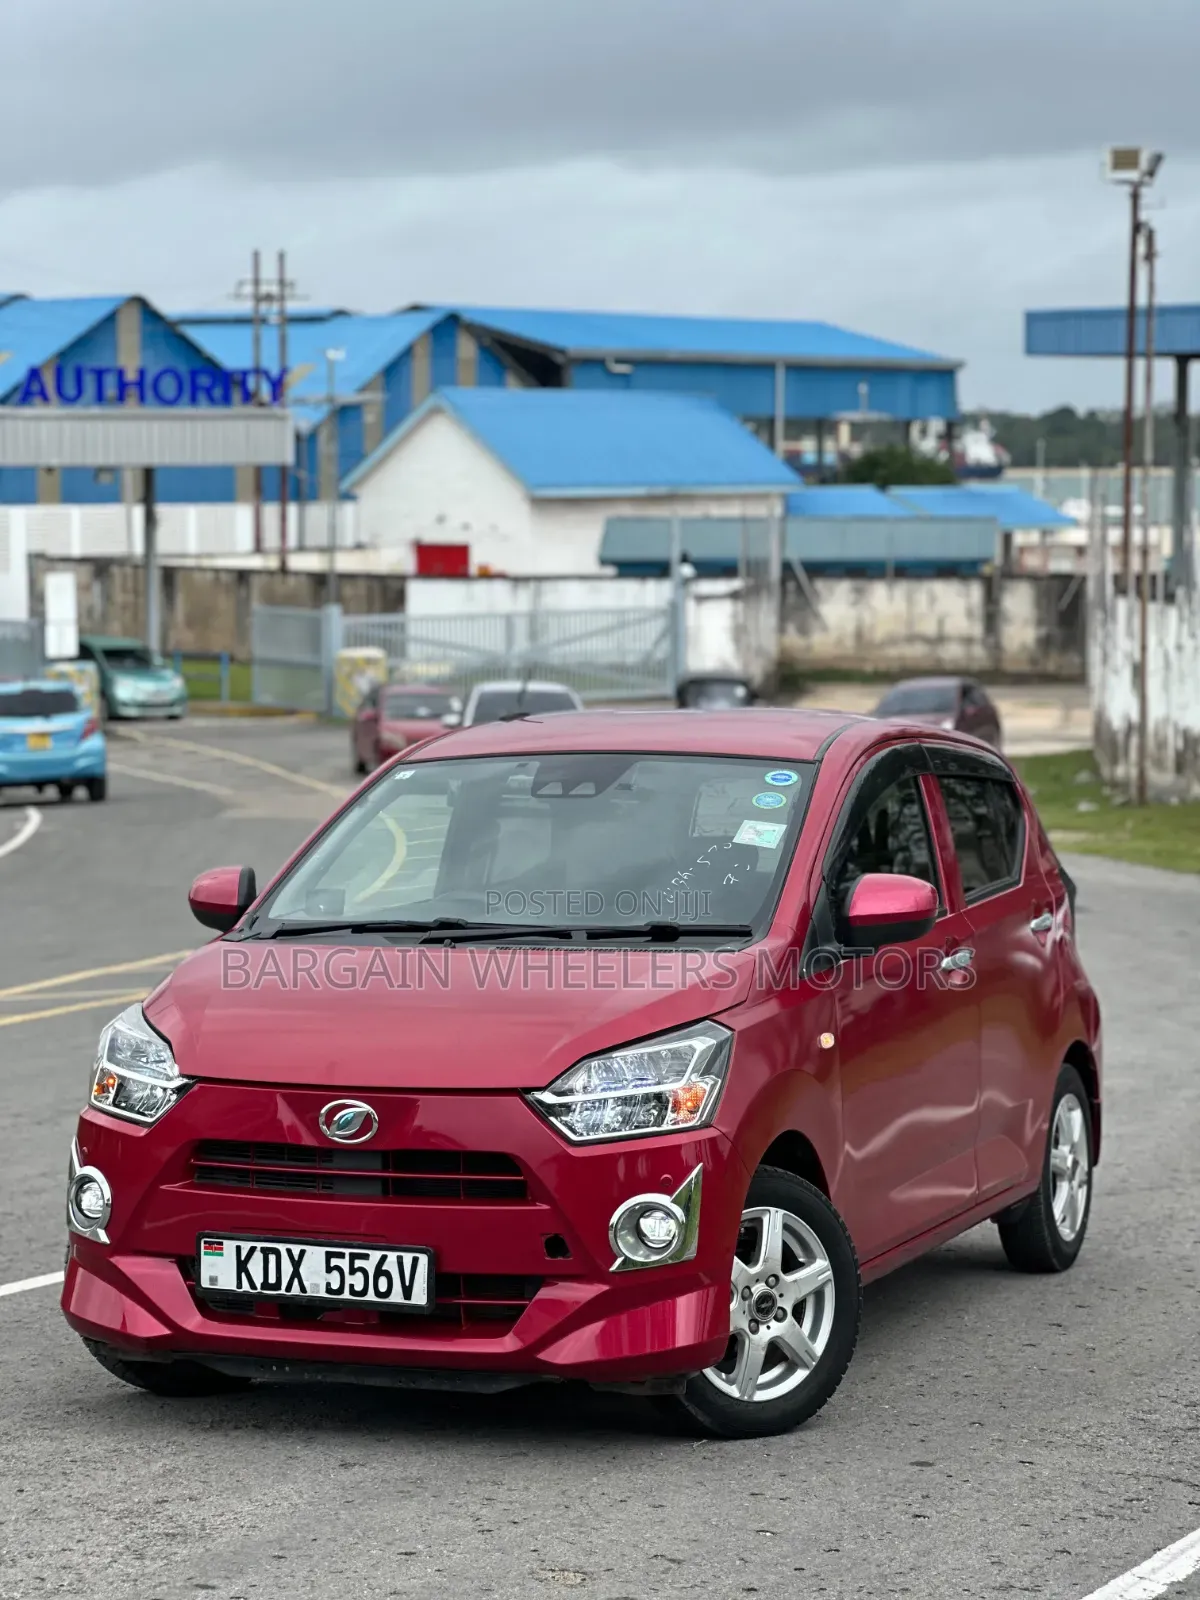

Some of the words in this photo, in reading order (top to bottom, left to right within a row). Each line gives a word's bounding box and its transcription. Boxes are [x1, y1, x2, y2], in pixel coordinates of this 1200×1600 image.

[20, 365, 289, 406] AUTHORITY
[235, 1244, 308, 1294] KDX
[324, 1250, 420, 1301] 556V
